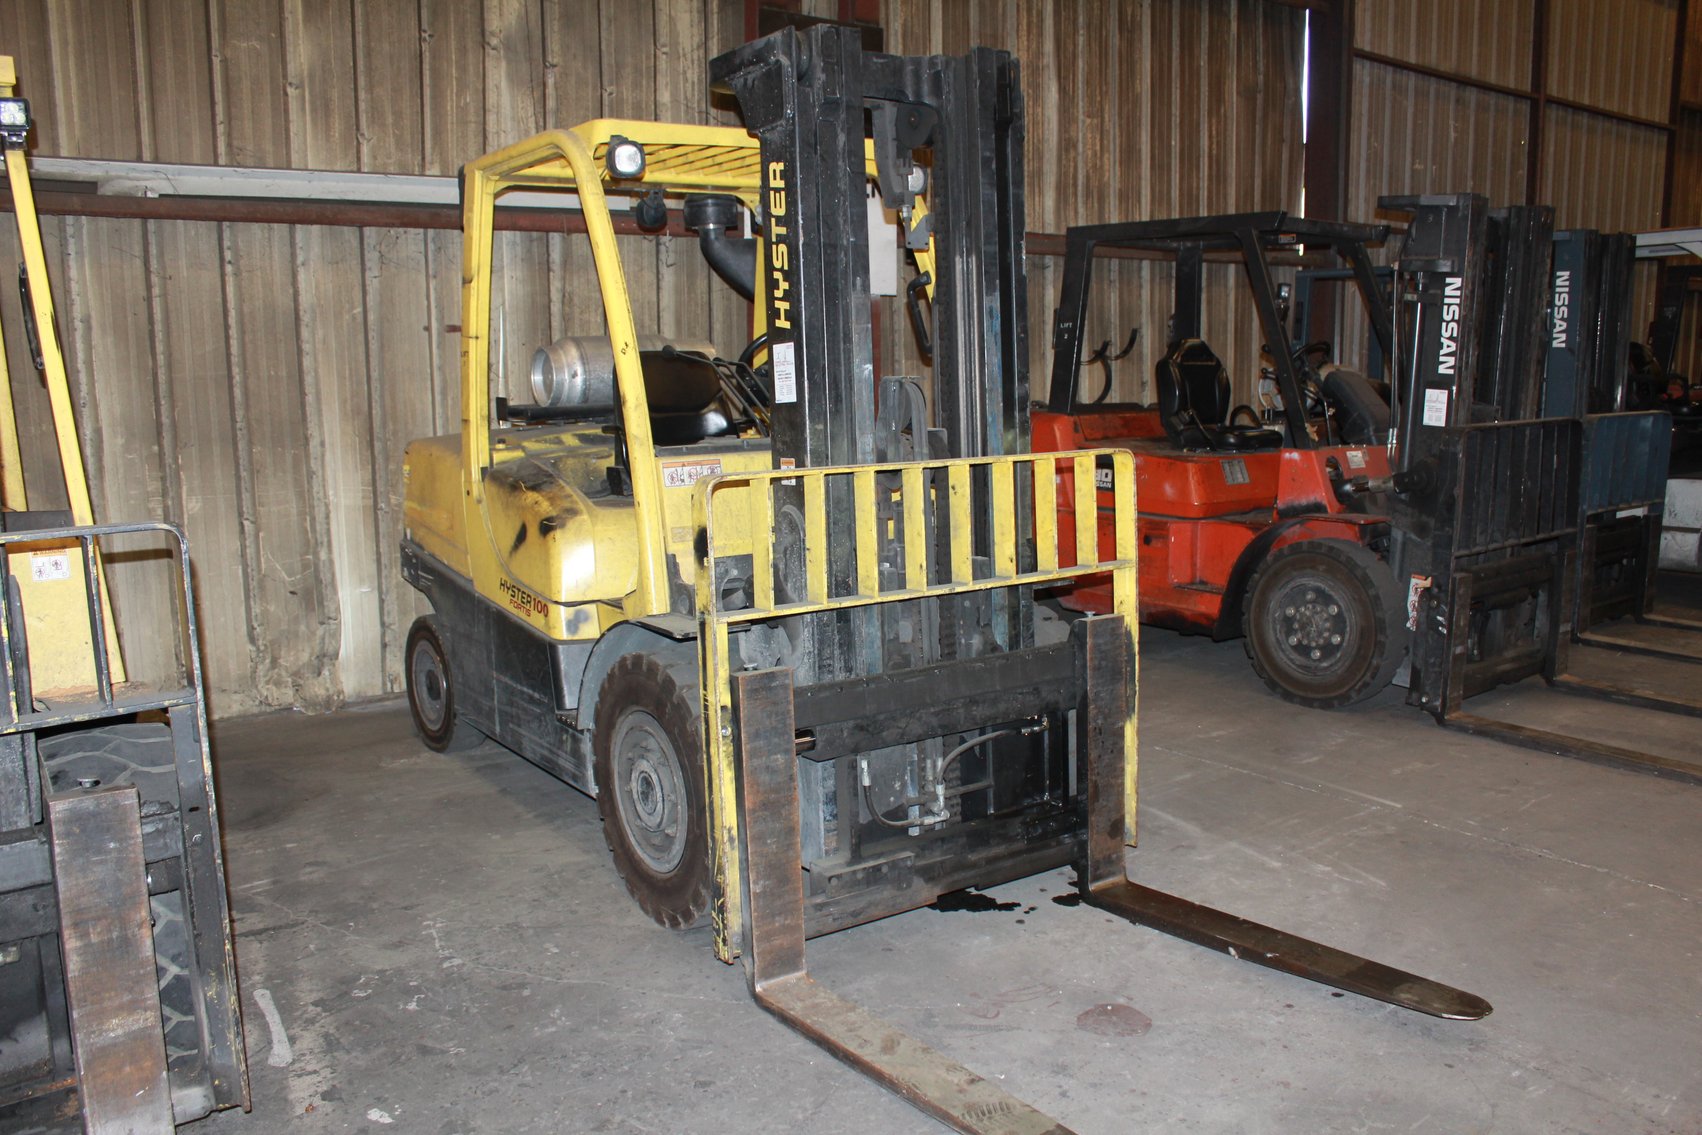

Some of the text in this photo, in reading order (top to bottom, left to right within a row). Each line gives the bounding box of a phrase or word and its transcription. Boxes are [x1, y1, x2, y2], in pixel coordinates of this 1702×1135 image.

[768, 161, 791, 329] HYSTER
[1438, 277, 1462, 375] NISSAN
[1552, 271, 1570, 348] NISSAN
[499, 577, 549, 618] HYSTER 100
[510, 598, 532, 617] FORTIS
